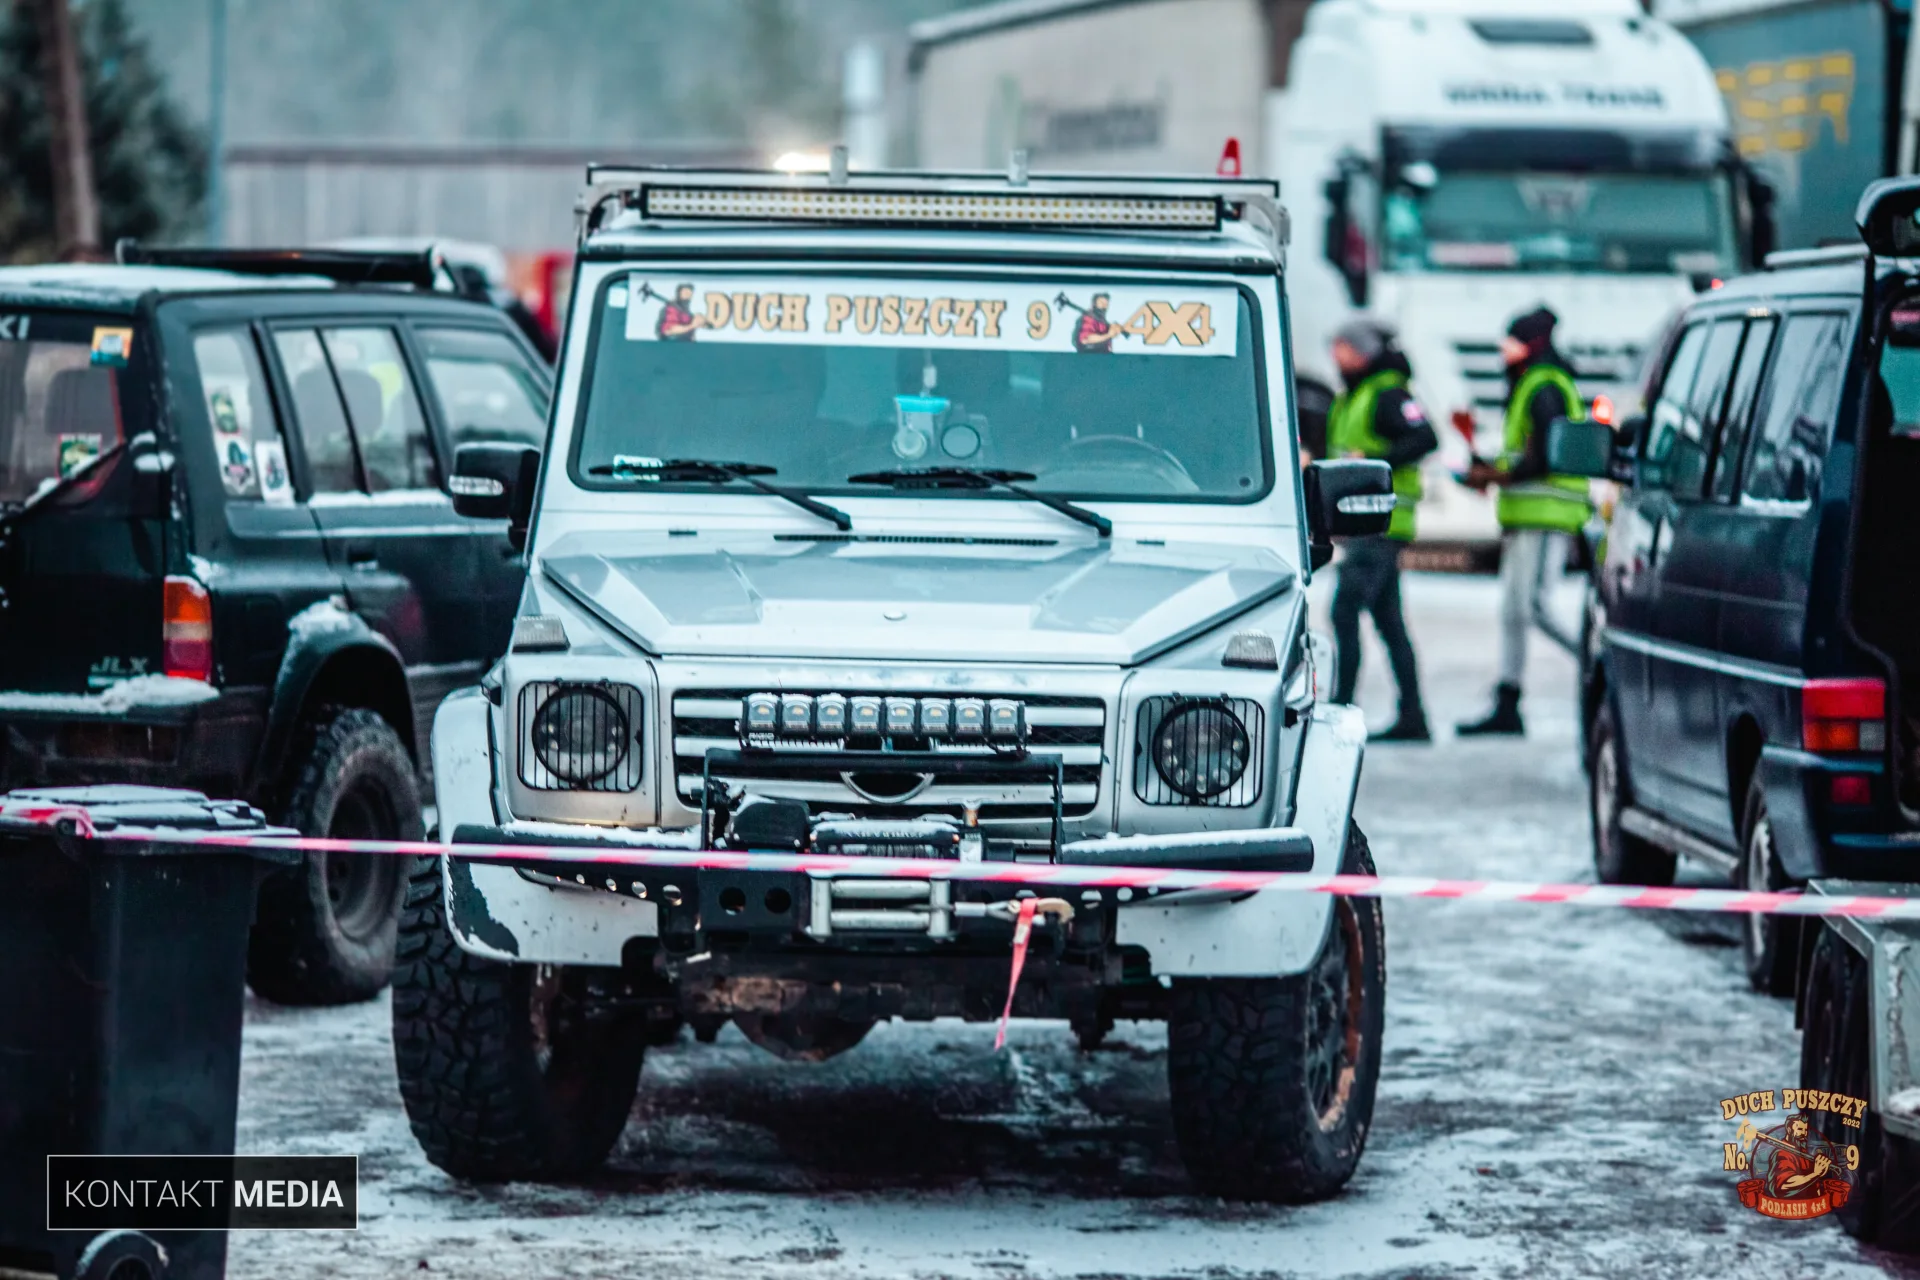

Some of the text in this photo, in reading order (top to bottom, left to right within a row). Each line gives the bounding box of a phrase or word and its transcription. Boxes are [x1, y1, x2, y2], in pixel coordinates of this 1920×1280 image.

[704, 292, 810, 333] DUCH
[825, 294, 1007, 338] PUSZCZY
[1027, 301, 1051, 340] 9
